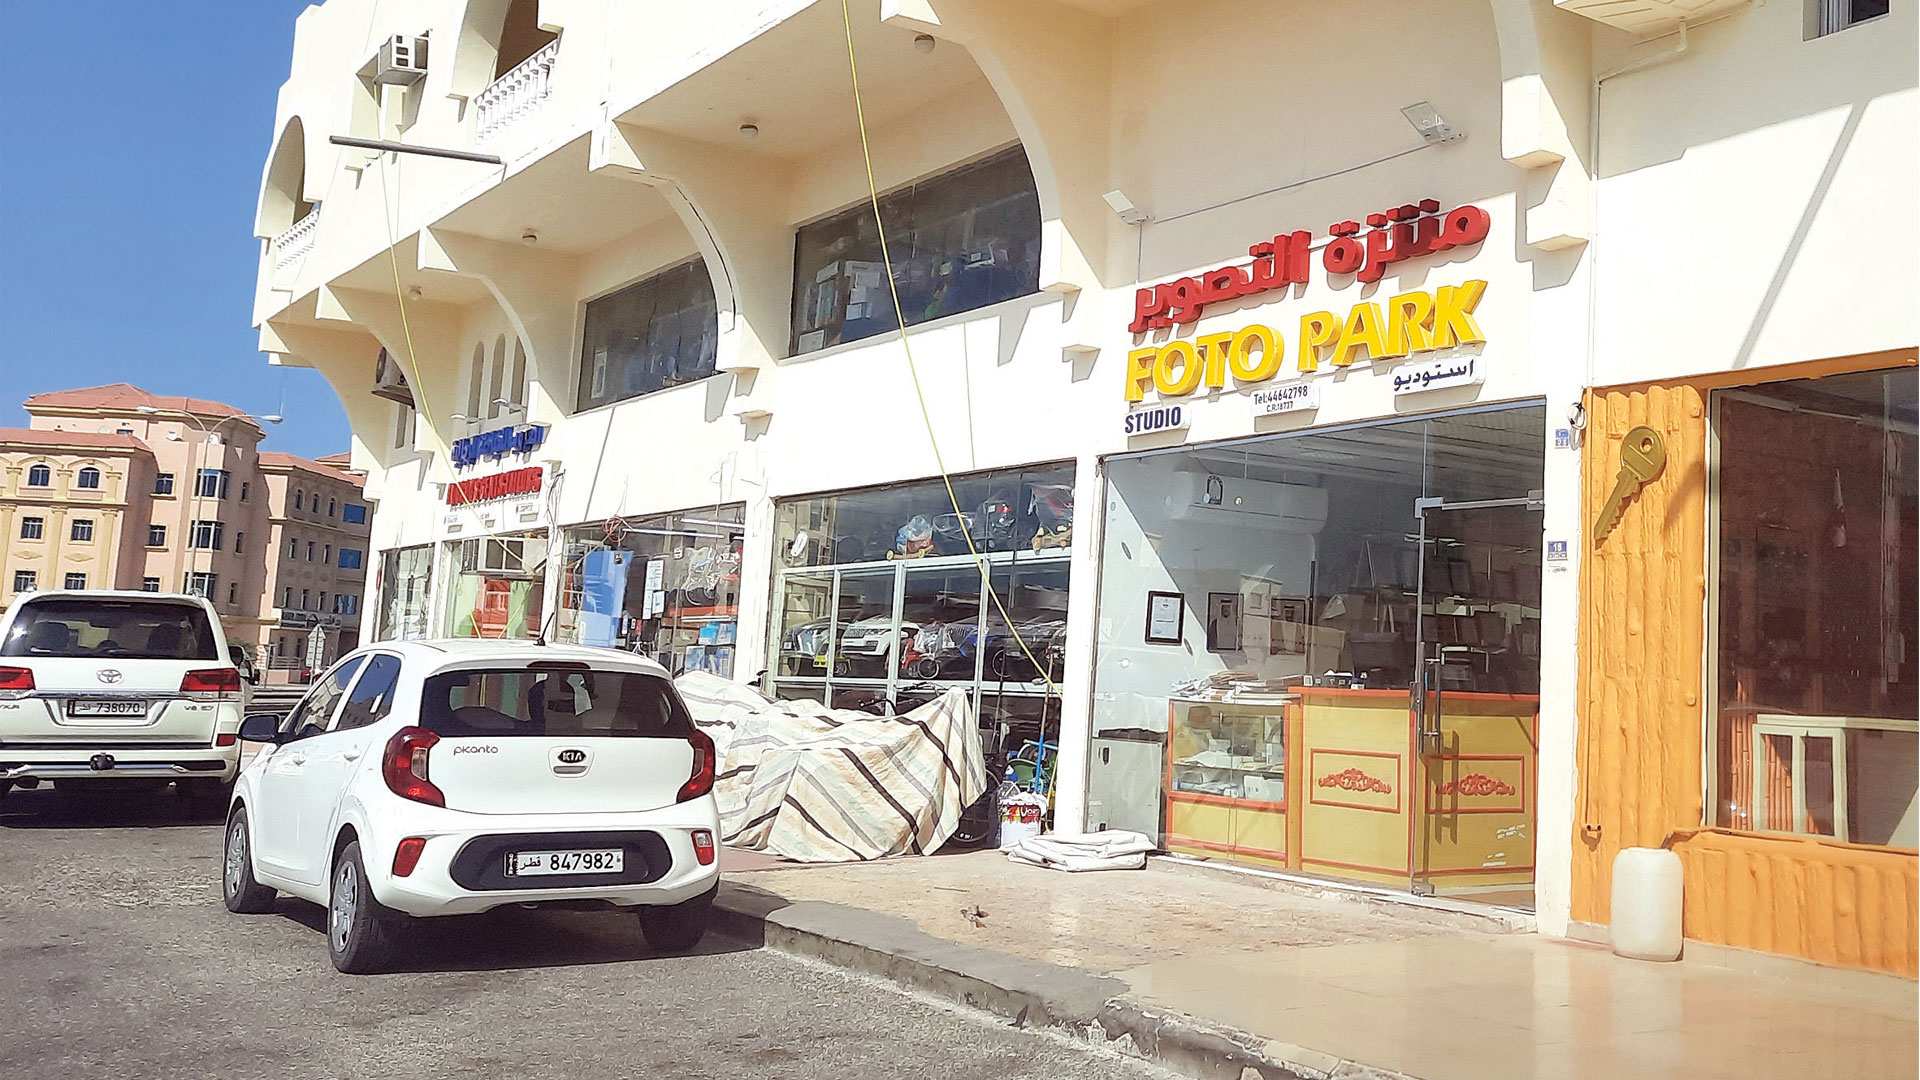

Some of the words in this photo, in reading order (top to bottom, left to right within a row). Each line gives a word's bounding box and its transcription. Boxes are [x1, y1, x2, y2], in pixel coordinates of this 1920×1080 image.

[1127, 229, 1312, 333] التصوير
[1124, 325, 1284, 402] FOTO
[1297, 279, 1489, 373] PARK
[1393, 359, 1475, 392] استوديو
[1253, 385, 1308, 405] Tel:44642798
[1125, 406, 1182, 434] STUDIO
[96, 702, 140, 713] 738070
[560, 751, 584, 761] KIA
[519, 856, 541, 870] قطر
[550, 852, 614, 871] 847982
